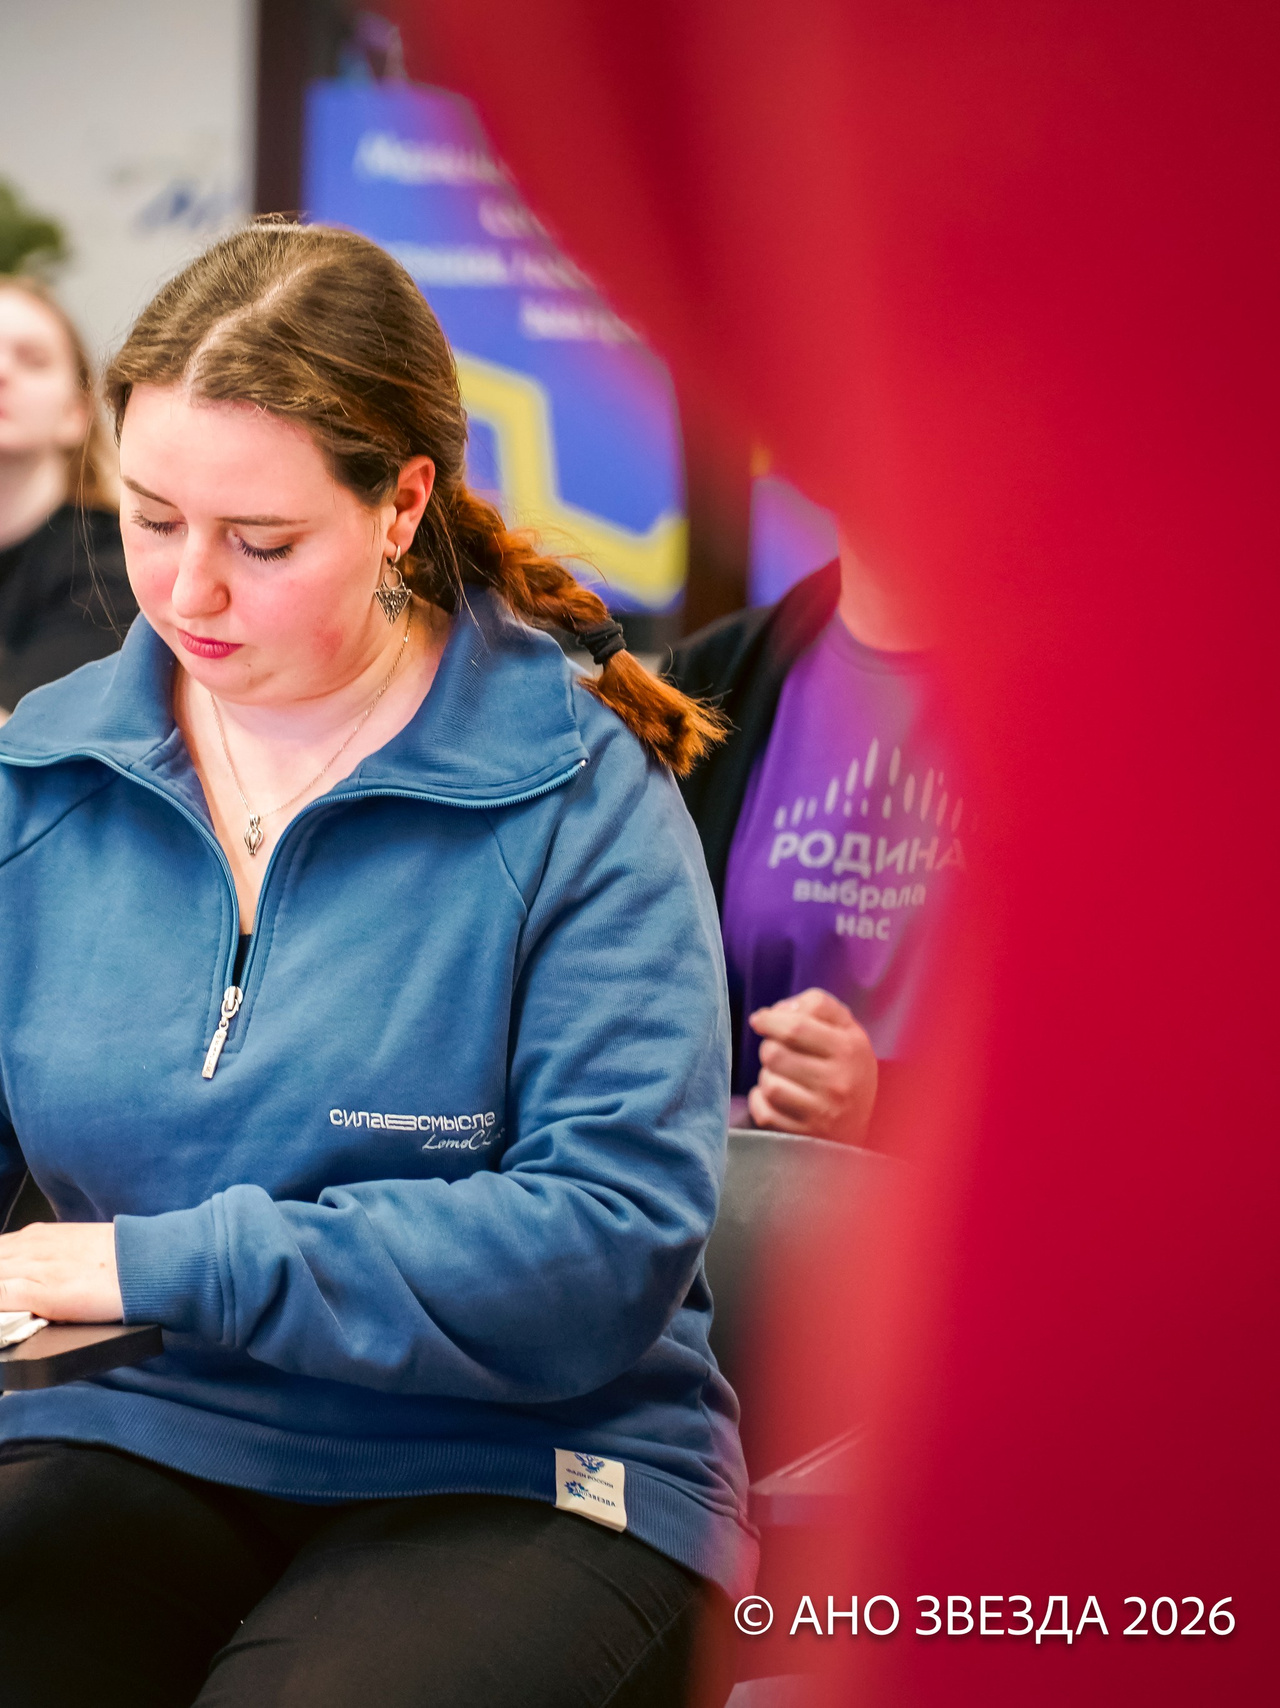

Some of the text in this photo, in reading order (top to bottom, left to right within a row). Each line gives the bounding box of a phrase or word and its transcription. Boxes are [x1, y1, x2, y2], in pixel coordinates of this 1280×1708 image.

[767, 829, 967, 879] РОДИНА
[792, 878, 927, 914] выбрала
[835, 912, 891, 941] нас
